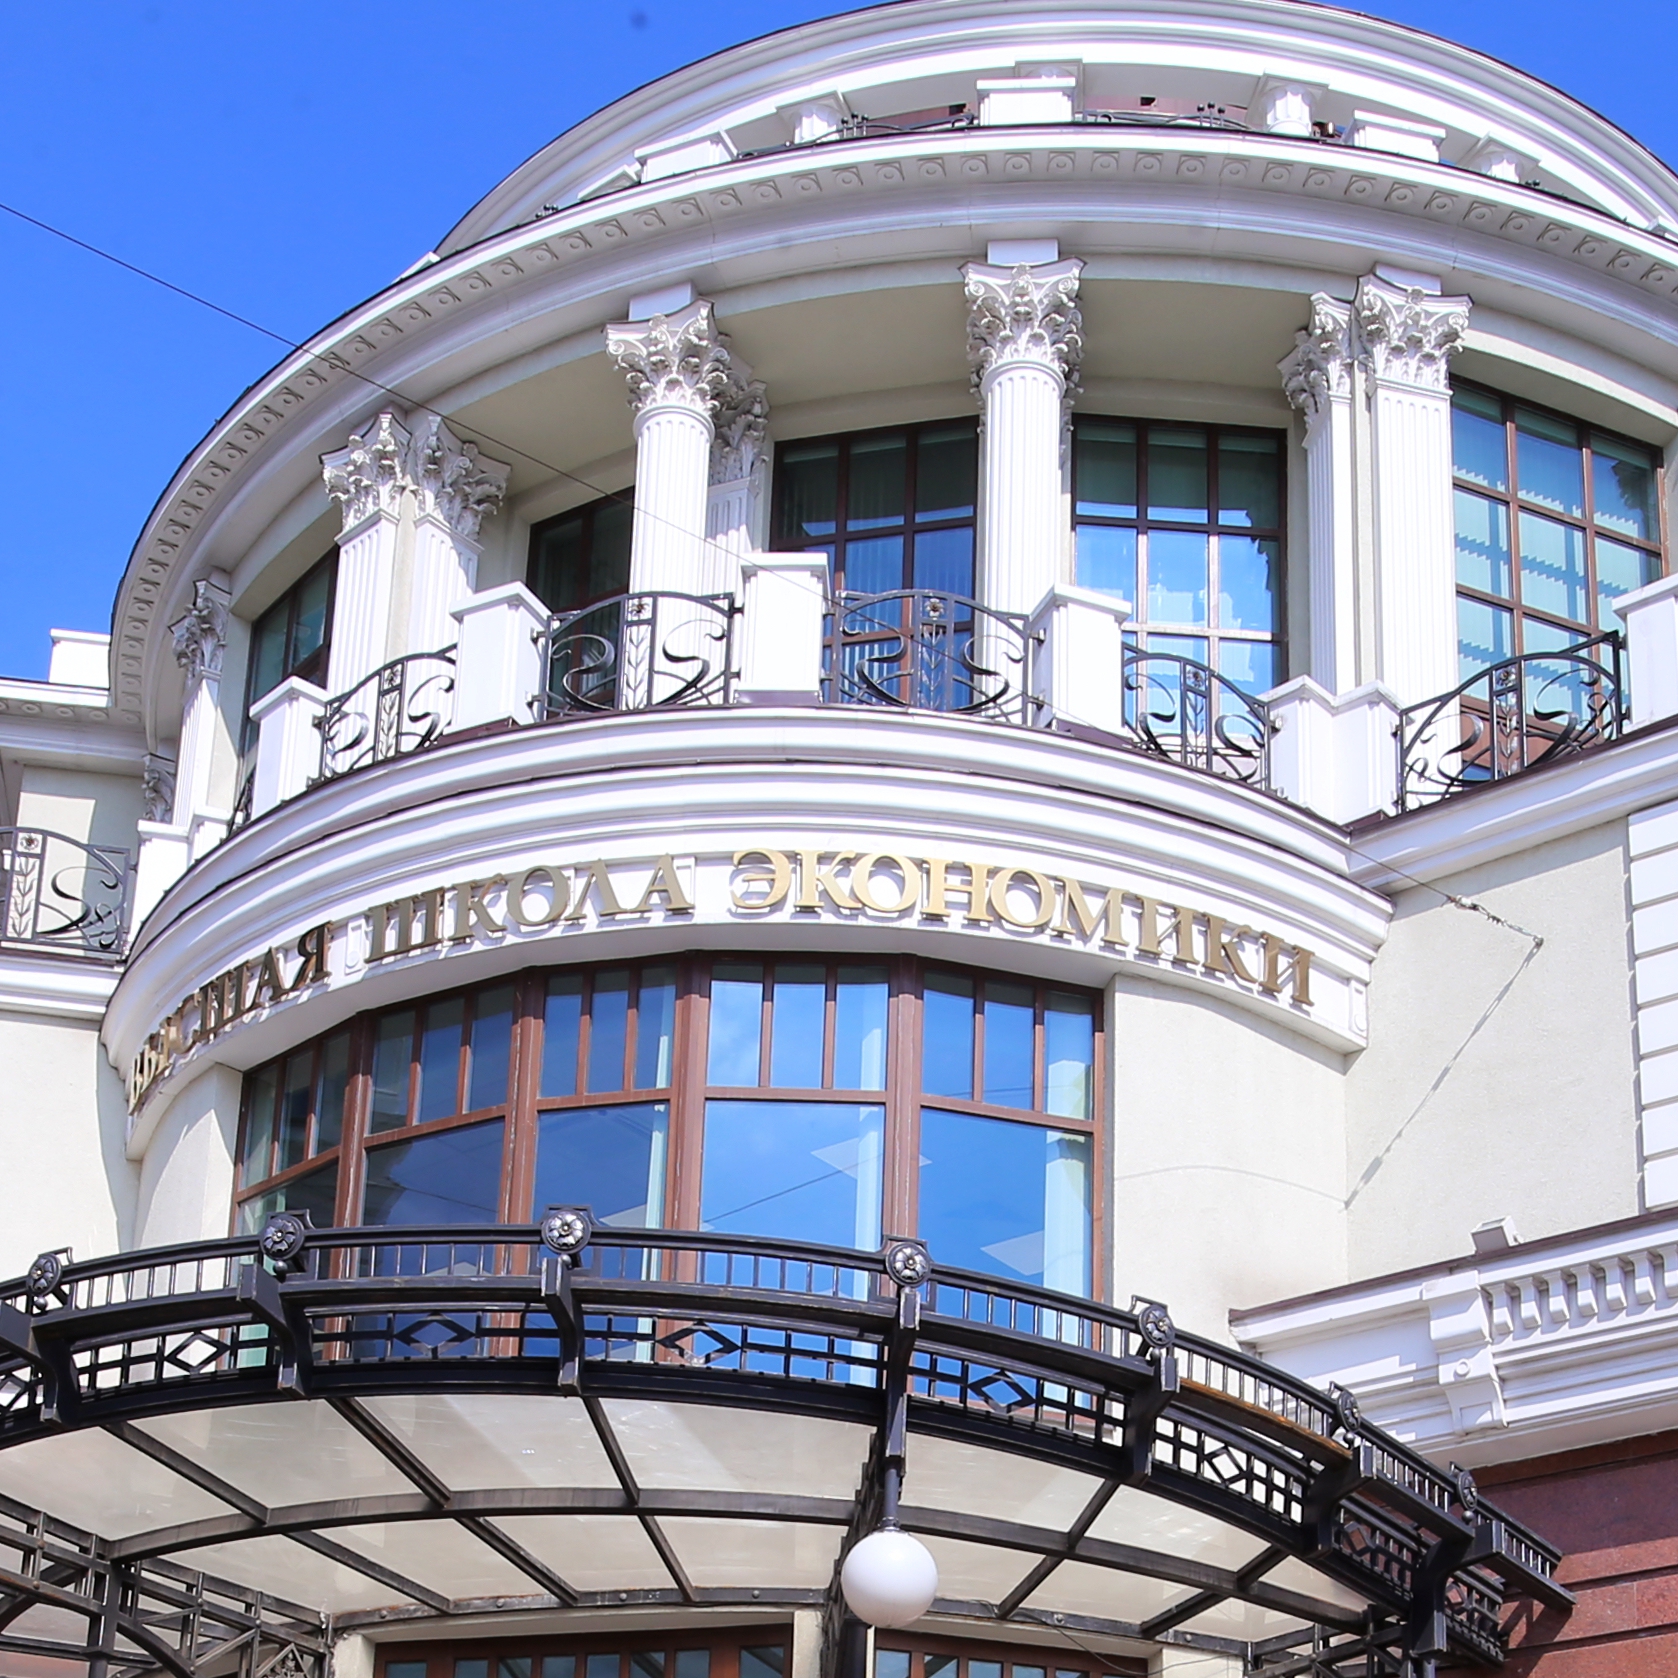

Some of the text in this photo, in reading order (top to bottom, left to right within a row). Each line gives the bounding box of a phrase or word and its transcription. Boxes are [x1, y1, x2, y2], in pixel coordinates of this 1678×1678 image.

[128, 847, 1316, 1116] ВЫСШАЯ ШКОЛА ЭКОНОМИКИ
